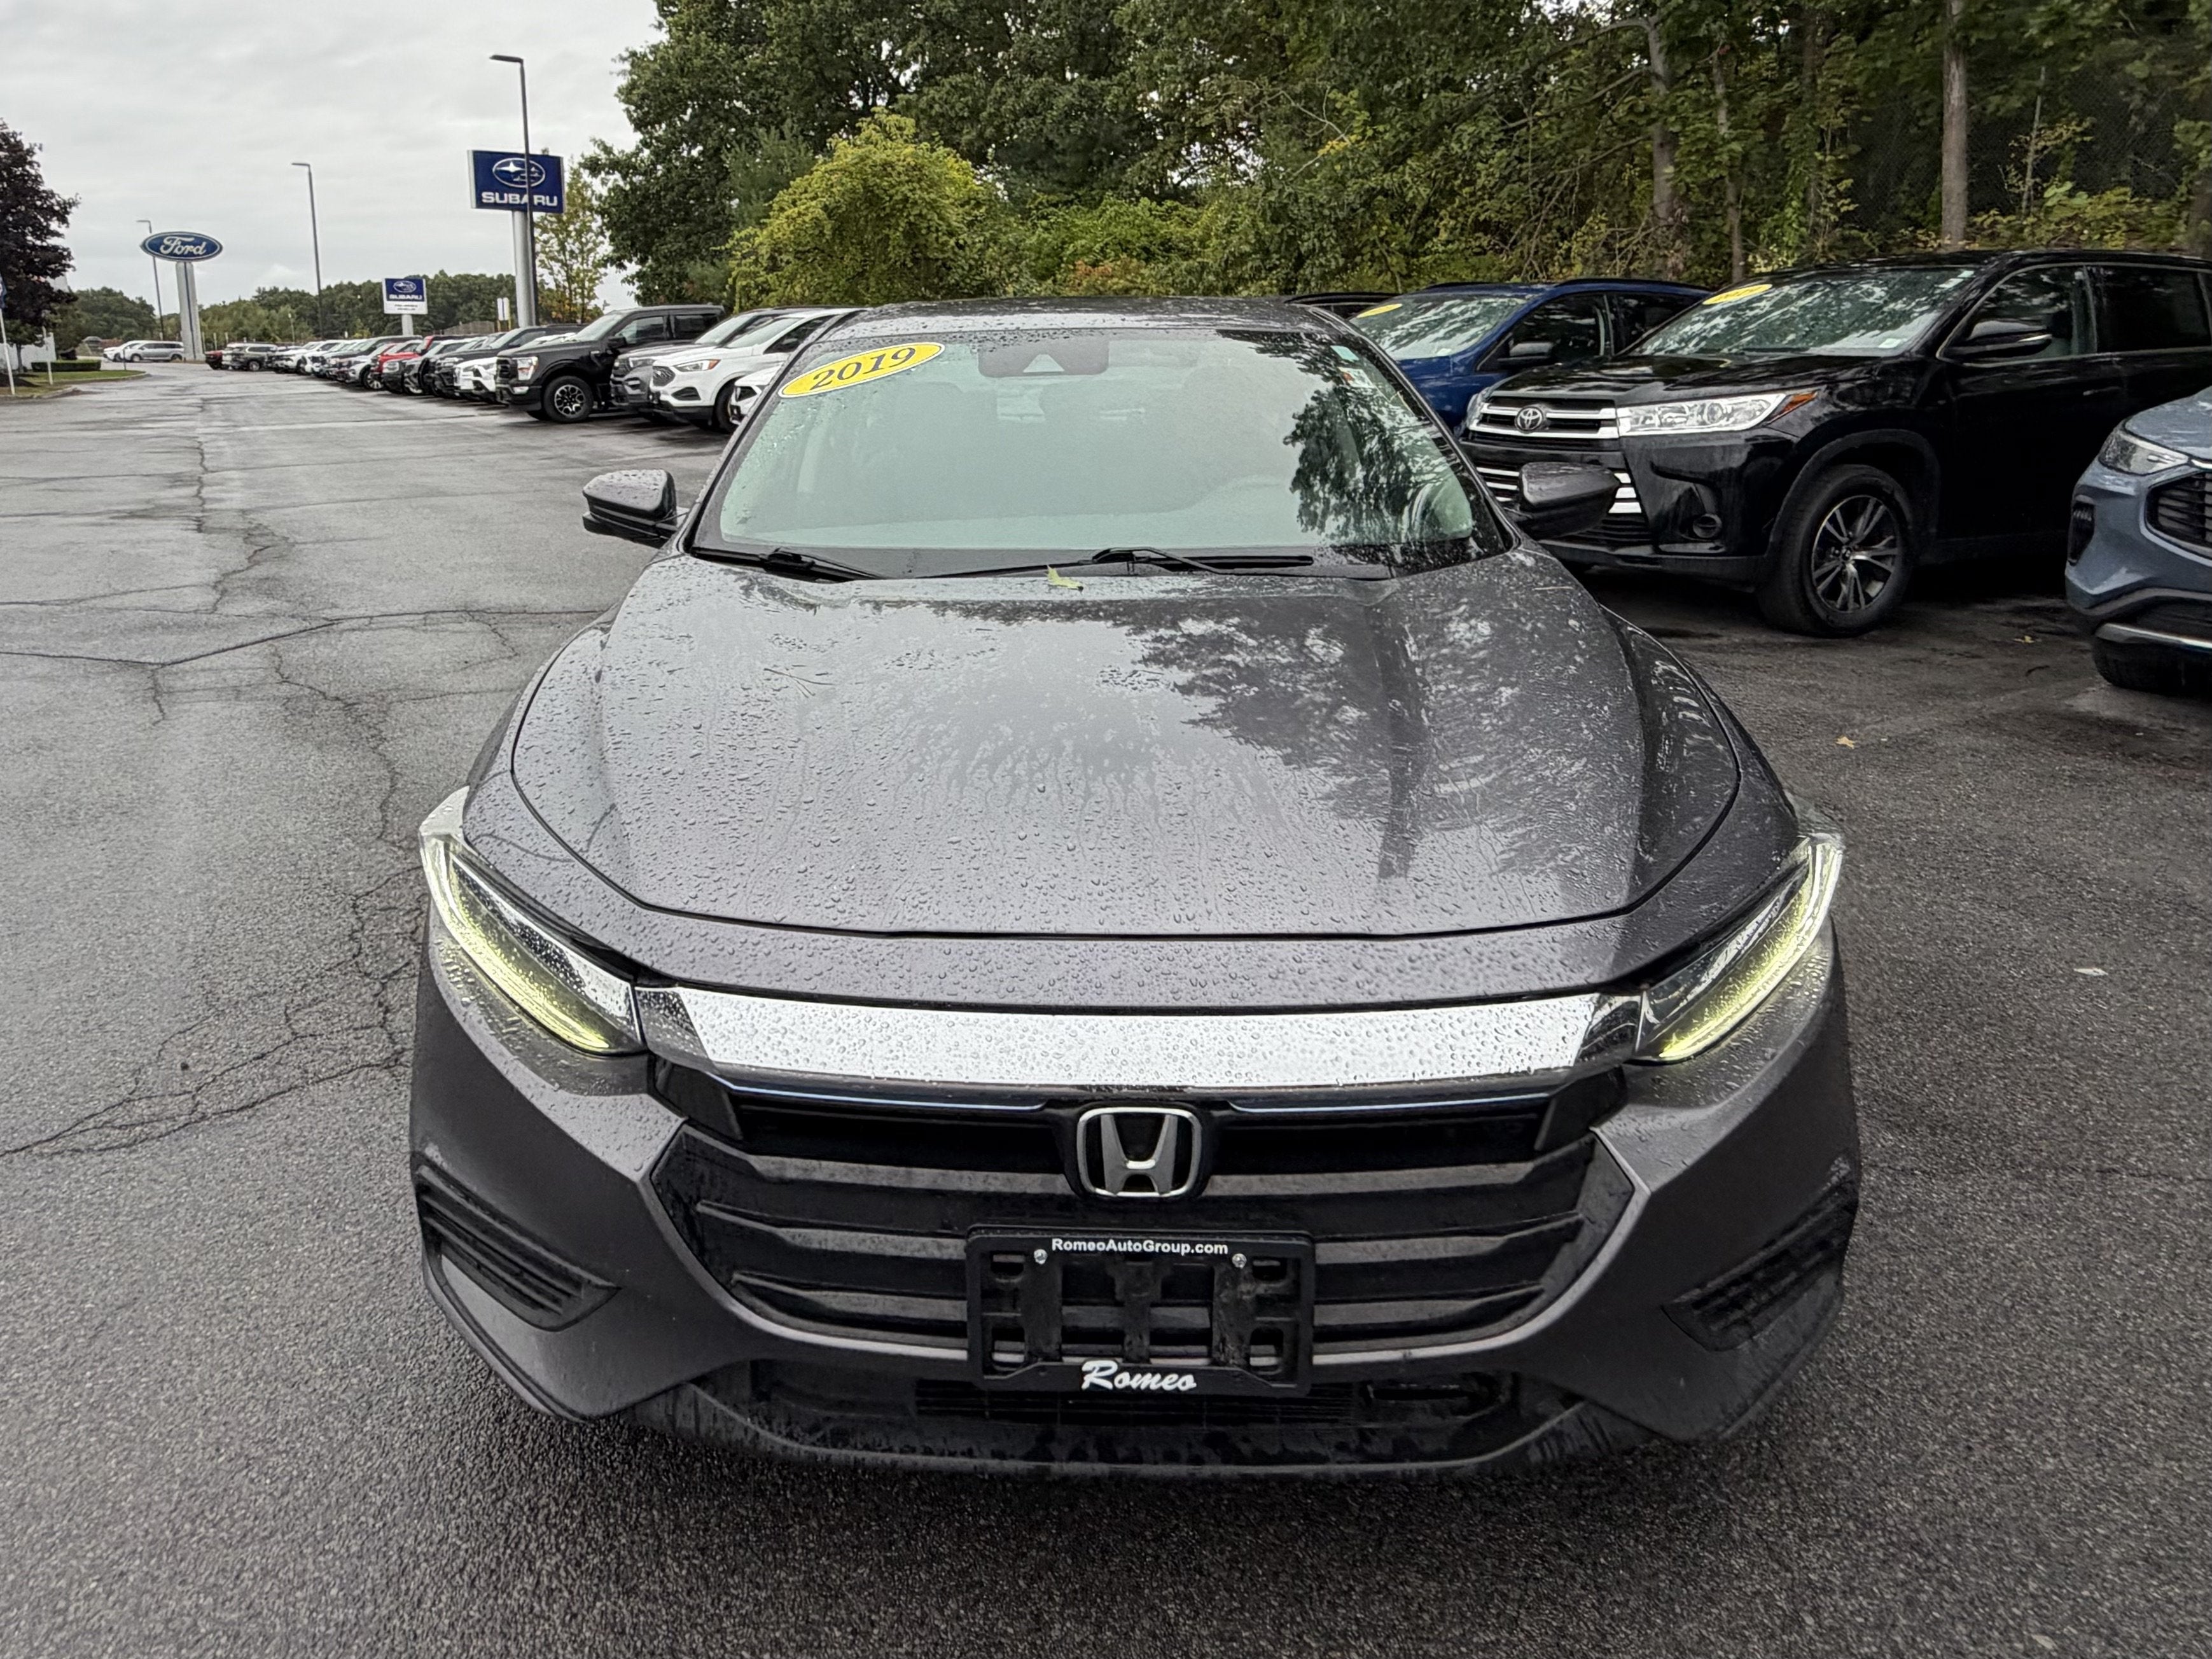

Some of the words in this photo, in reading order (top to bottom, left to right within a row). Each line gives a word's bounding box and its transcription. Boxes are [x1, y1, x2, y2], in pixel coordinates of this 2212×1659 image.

[160, 236, 207, 254] Ford
[810, 347, 915, 390] 2019
[1052, 1238, 1228, 1256] RomeoAutoGroup.com
[1082, 1360, 1197, 1391] Romeo
